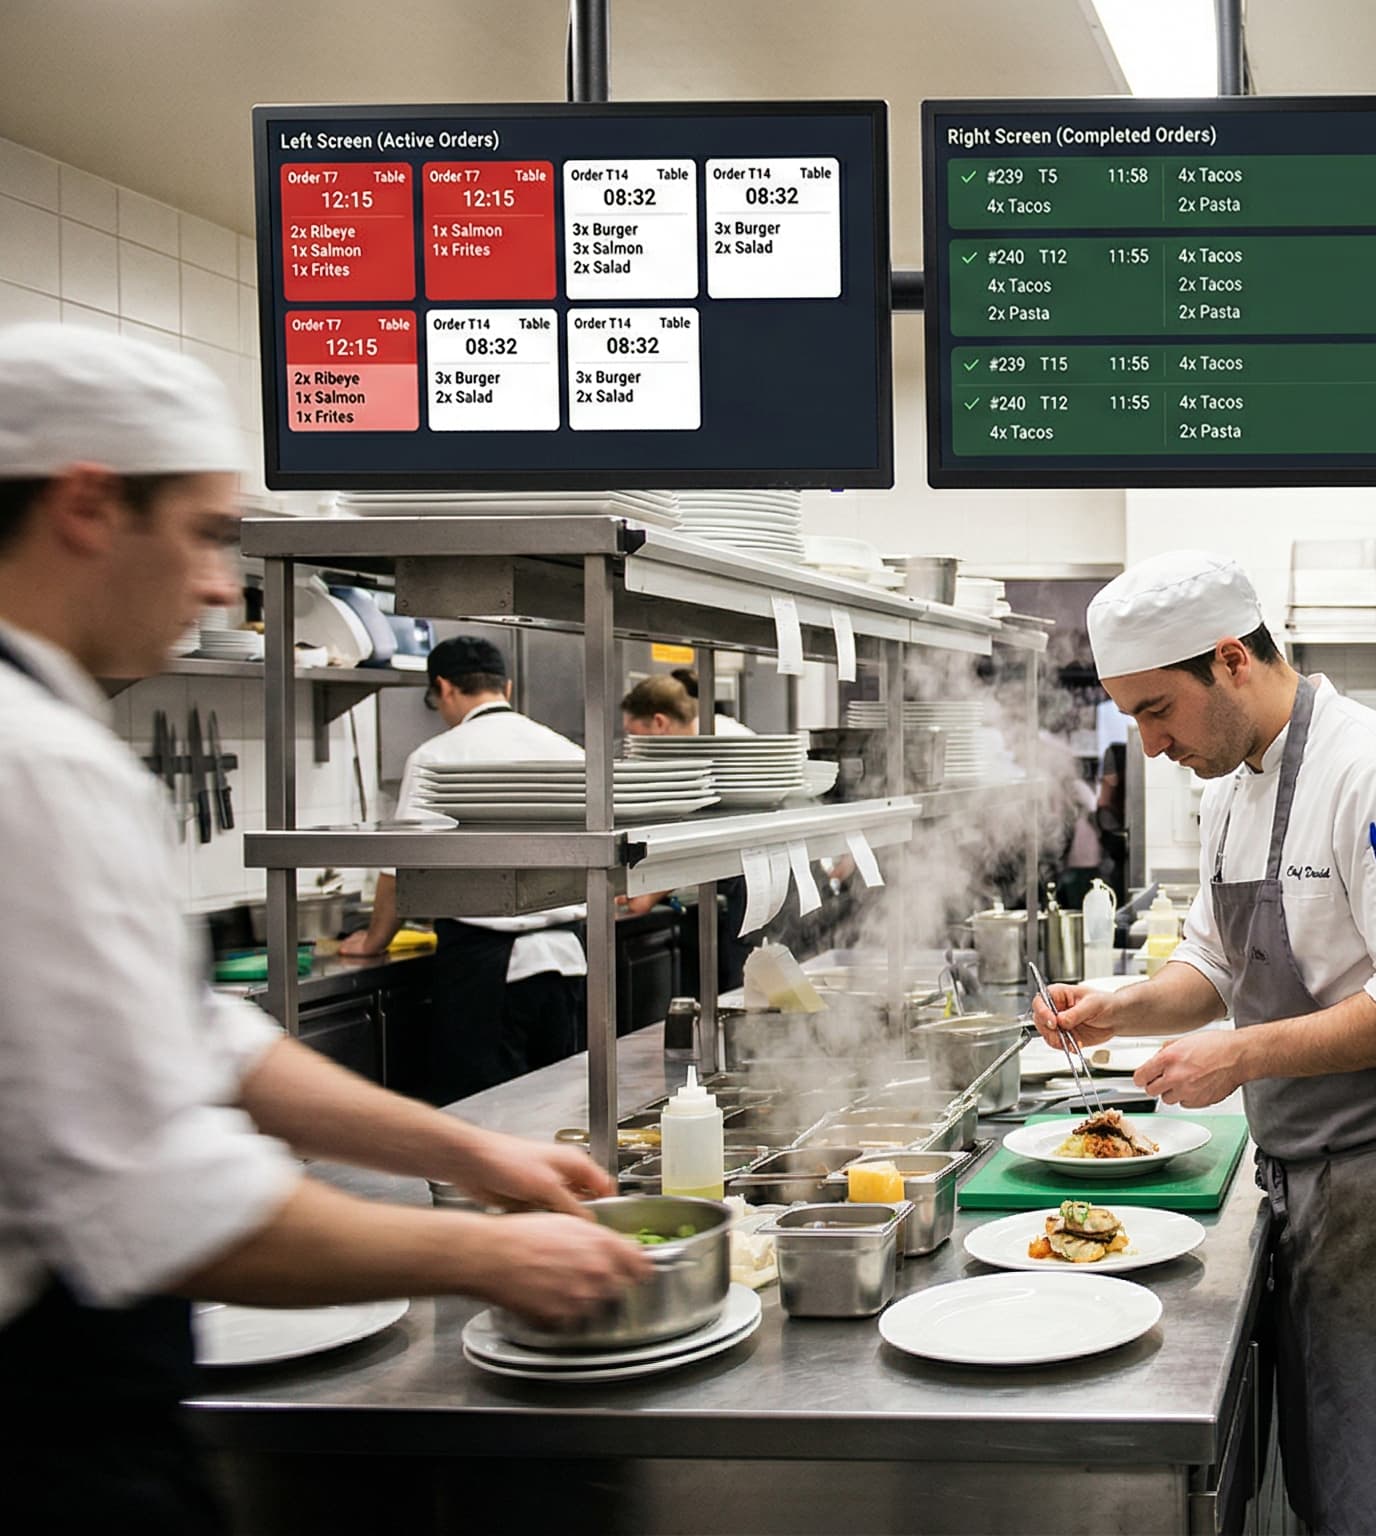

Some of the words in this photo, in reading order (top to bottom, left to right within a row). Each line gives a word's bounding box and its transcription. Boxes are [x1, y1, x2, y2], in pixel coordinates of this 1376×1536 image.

[282, 133, 312, 148] Left
[318, 133, 372, 148] Screen
[378, 132, 434, 151] (Active
[439, 130, 498, 150] Orders)
[949, 128, 990, 148] Right
[995, 128, 1051, 143] Screen
[1057, 127, 1150, 147] (Completed
[1156, 126, 1216, 145] Orders)
[288, 171, 320, 183] Order
[323, 172, 337, 183] T7
[374, 170, 405, 182] Table
[430, 170, 461, 182] Order
[465, 170, 479, 181] T7
[515, 169, 546, 181] Table
[571, 169, 603, 181] Order
[606, 169, 628, 180] T14
[657, 168, 688, 180] Table
[713, 168, 745, 179] Order
[748, 168, 770, 179] T14
[800, 167, 831, 179] Table
[988, 169, 1023, 184] #239
[1039, 169, 1057, 183] T5
[1109, 168, 1148, 182] 11:58
[1179, 168, 1195, 182] 4x
[1199, 168, 1242, 182] Tacos
[322, 191, 372, 208] 12:15
[464, 190, 514, 206] 12:15
[604, 189, 656, 205] 08:32
[746, 187, 798, 204] 08:32
[988, 199, 1004, 212] 4x
[1008, 199, 1051, 213] Tacos
[1179, 197, 1195, 212] 2x
[1200, 197, 1240, 211] Pasta
[291, 226, 307, 238] 2x
[433, 225, 447, 237] 1x
[452, 223, 502, 237] Salmon
[573, 223, 588, 236] 3x
[593, 223, 638, 238] Burger
[715, 222, 731, 235] 3x
[735, 222, 780, 237] Burger
[292, 245, 307, 257] 1x
[311, 243, 361, 257] Salmon
[433, 244, 448, 256] 1x
[453, 243, 490, 256] Frites
[573, 242, 589, 255] 3x
[594, 241, 643, 255] Salmon
[715, 241, 731, 254] 2x
[735, 240, 772, 254] Salad
[989, 250, 1024, 264] #240
[1040, 249, 1066, 263] T12
[1110, 249, 1148, 263] 11:55
[1179, 249, 1195, 262] 4x
[1200, 248, 1242, 262] Tacos
[292, 264, 307, 276] 1x
[312, 263, 349, 276] Frites
[574, 261, 589, 274] 2x
[594, 260, 630, 273] Salad
[988, 279, 1005, 292] 4x
[1009, 278, 1051, 292] Tacos
[1179, 277, 1195, 291] 2x
[1200, 277, 1242, 291] Tacos
[988, 306, 1005, 320] 2x
[1010, 306, 1049, 320] Pasta
[1180, 305, 1195, 319] 2x
[1201, 305, 1240, 318] Pasta
[292, 319, 324, 330] Order
[326, 319, 341, 330] T7
[379, 318, 409, 330] Table
[434, 318, 465, 330] Order
[467, 319, 490, 329] T14
[519, 318, 550, 329] Table
[575, 317, 606, 329] Order
[608, 318, 631, 328] T14
[660, 317, 690, 328] Table
[327, 339, 377, 355] 12:15
[466, 338, 517, 355] 08:32
[607, 337, 659, 354] 08:32
[990, 357, 1025, 371] #239
[1040, 357, 1067, 371] T15
[1180, 357, 1196, 370] 4x
[1200, 356, 1242, 370] Tacos
[295, 372, 311, 384] 2x
[315, 371, 359, 387] Ribeye
[436, 371, 451, 384] 3x
[456, 371, 500, 387] Burger
[576, 371, 592, 383] 3x
[596, 371, 641, 387] Burger
[296, 392, 311, 403] 1x
[315, 390, 365, 404] Salmon
[436, 391, 452, 403] 2x
[456, 388, 492, 403] Salad
[577, 390, 592, 402] 2x
[596, 388, 633, 403] Salad
[990, 396, 1025, 410] #240
[1040, 396, 1067, 410] T12
[1111, 395, 1149, 409] 11:55
[1180, 396, 1196, 408] 4x
[1200, 395, 1243, 409] Tacos
[297, 411, 311, 423] 1x
[316, 410, 354, 423] Frites
[990, 426, 1007, 439] 4x
[1011, 425, 1053, 439] Tacos
[1180, 424, 1196, 438] 2x
[1201, 424, 1241, 438] Pasta
